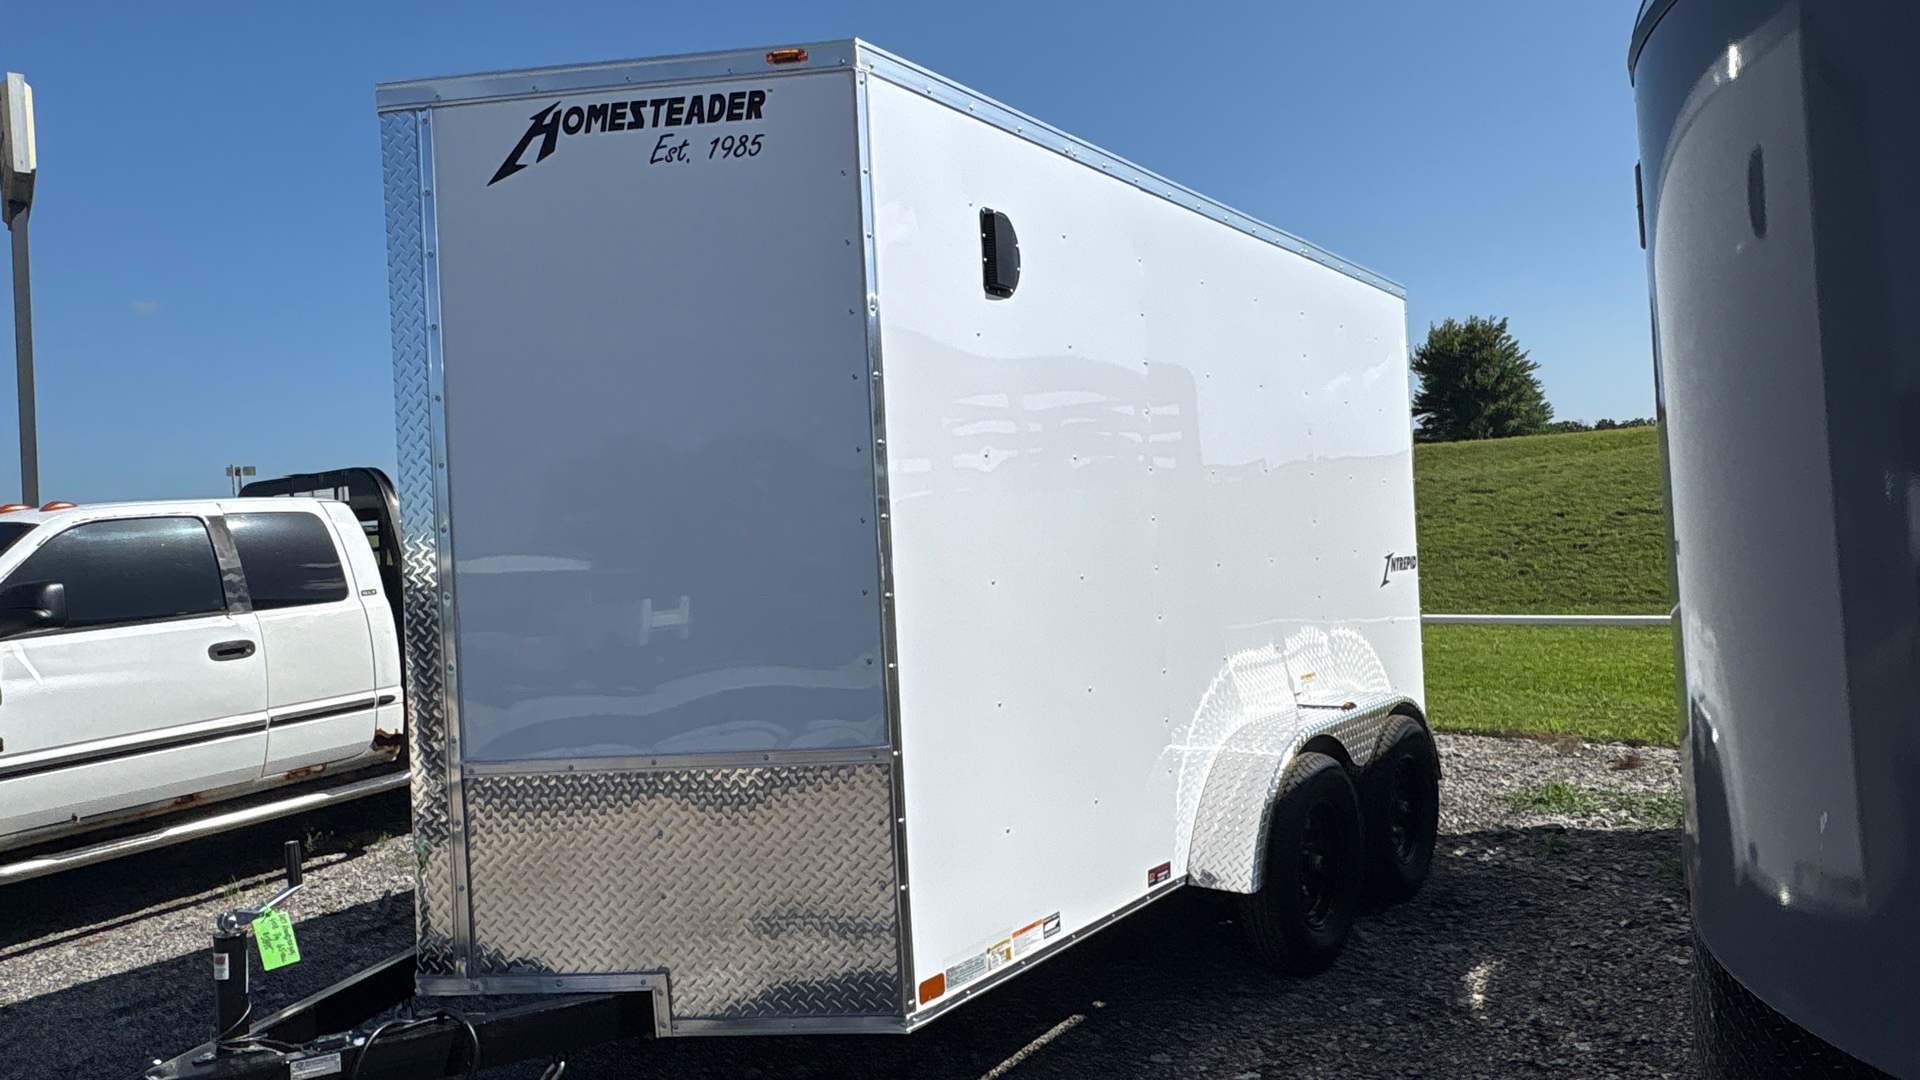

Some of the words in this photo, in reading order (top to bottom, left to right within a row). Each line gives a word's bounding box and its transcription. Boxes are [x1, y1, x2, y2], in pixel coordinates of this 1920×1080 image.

[487, 89, 766, 187] HOMESTEADER
[649, 133, 690, 165] Est.
[708, 133, 765, 160] 1985
